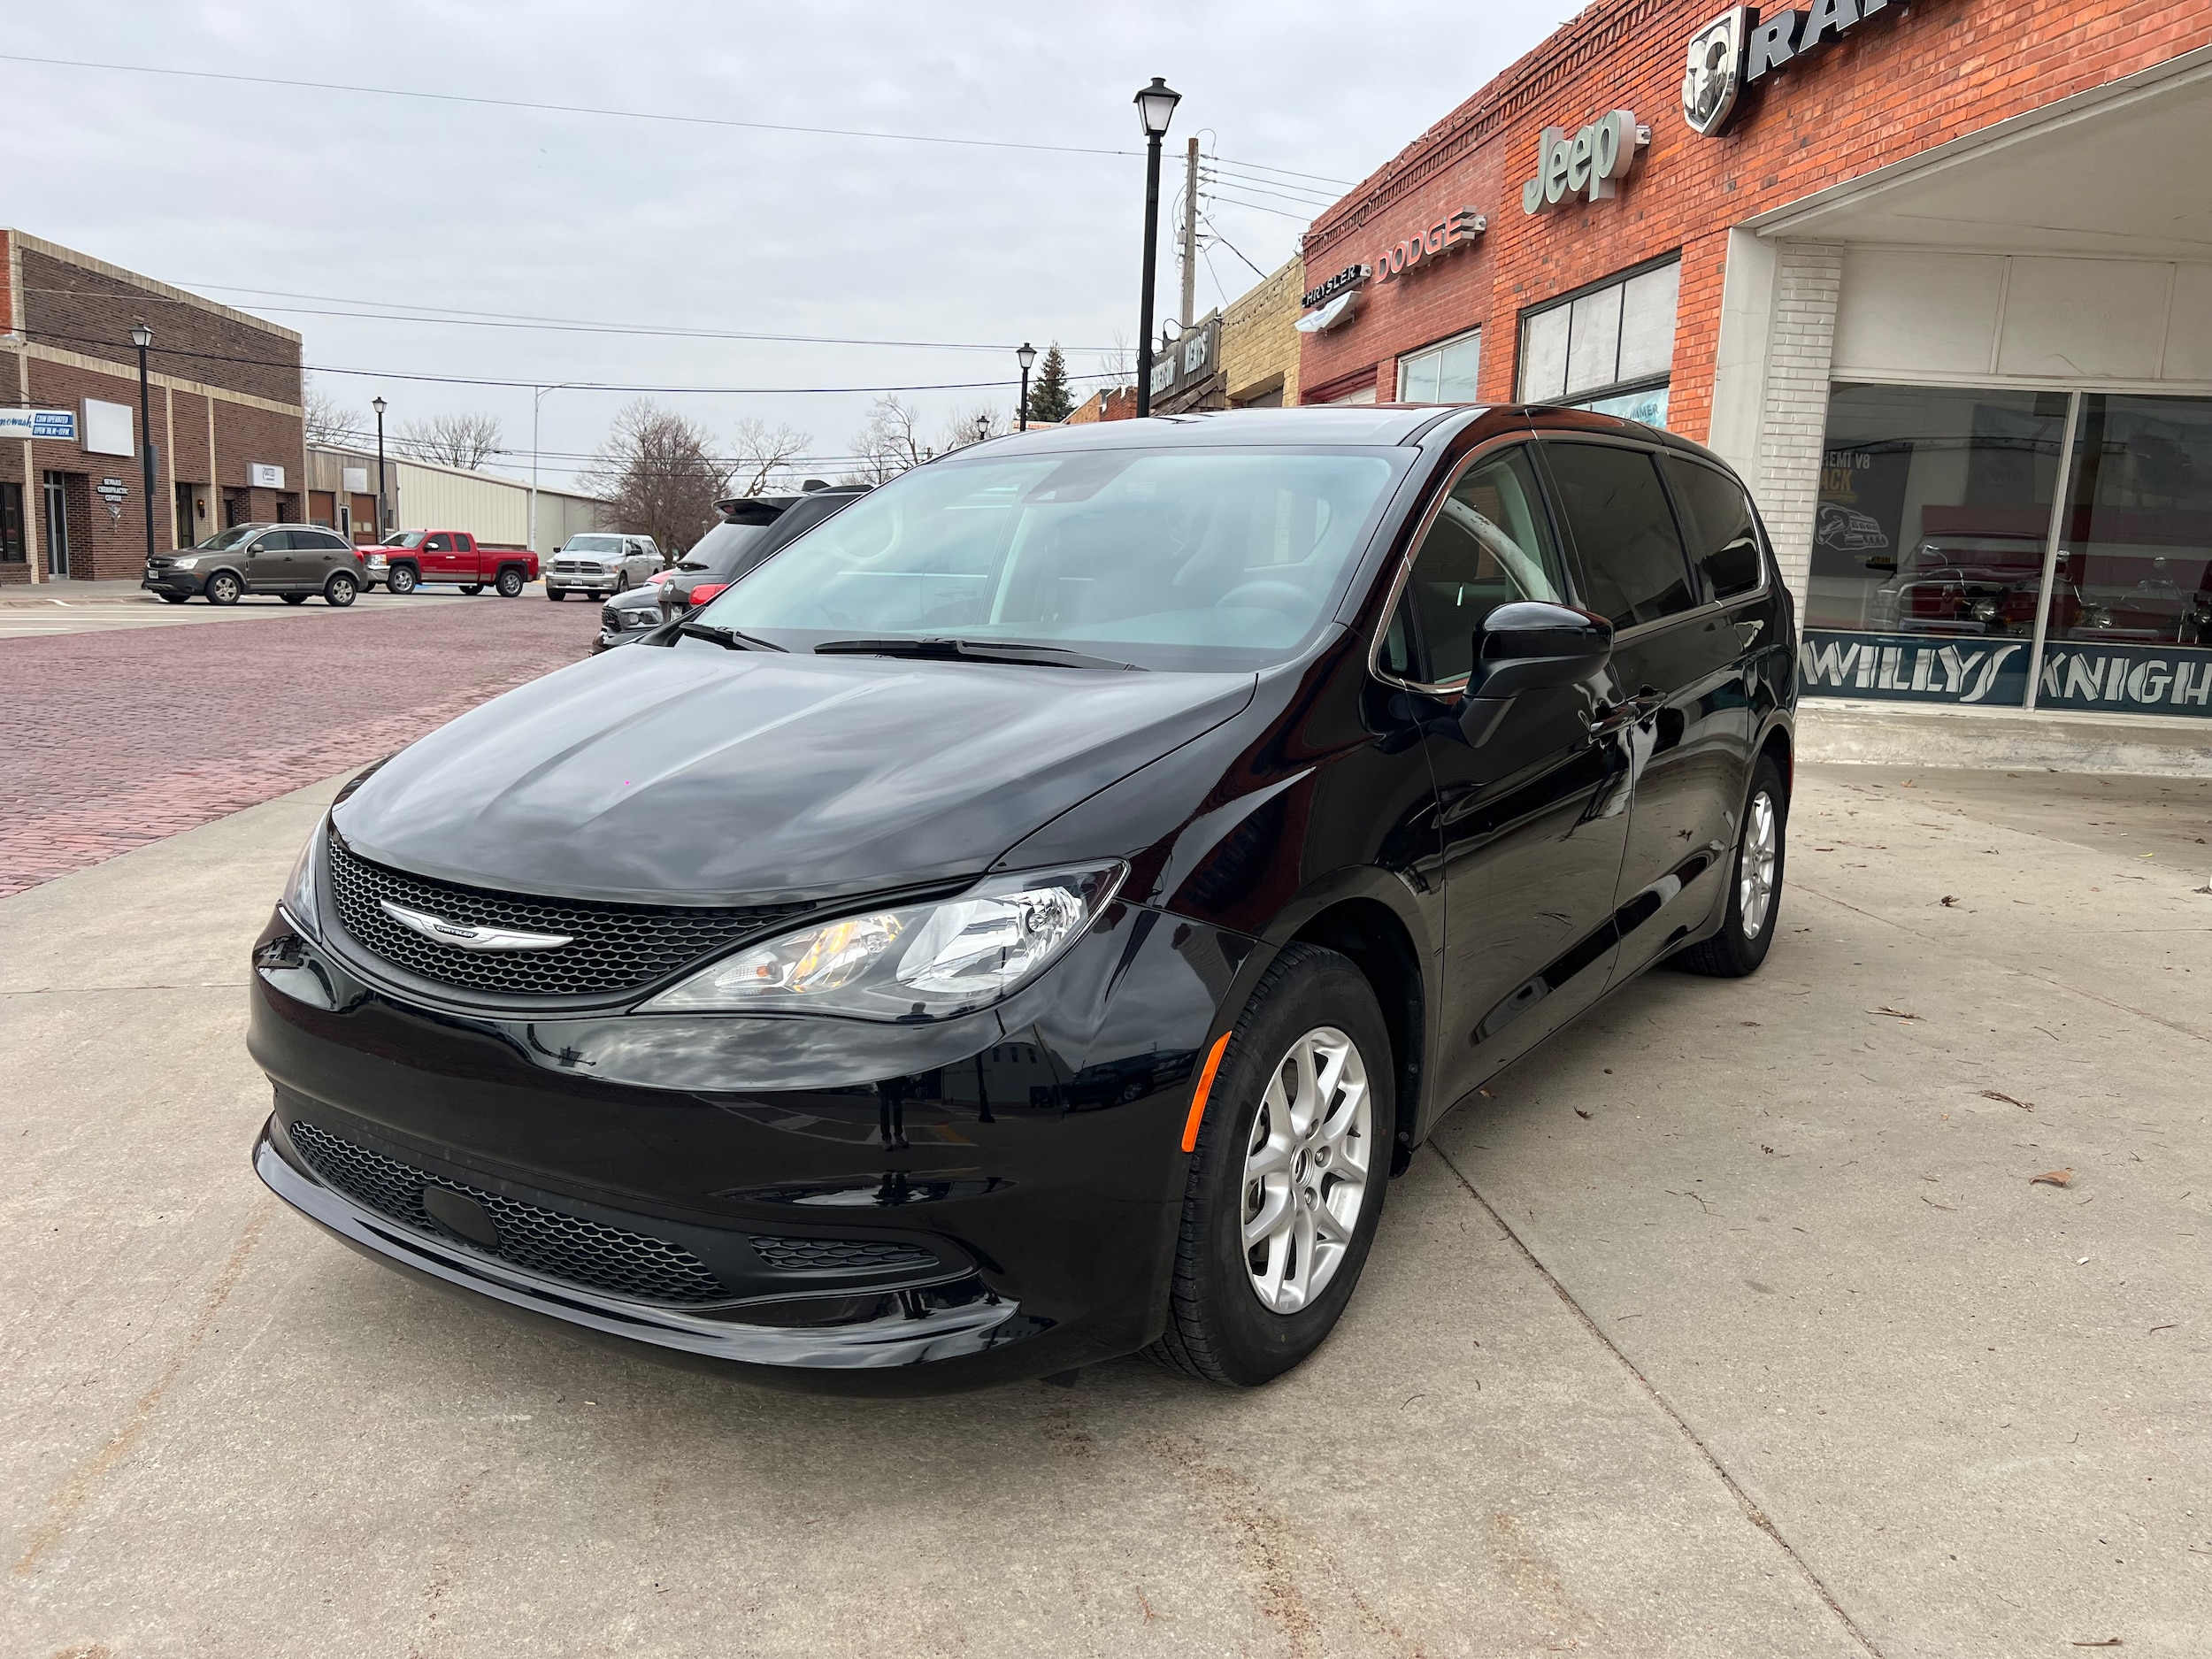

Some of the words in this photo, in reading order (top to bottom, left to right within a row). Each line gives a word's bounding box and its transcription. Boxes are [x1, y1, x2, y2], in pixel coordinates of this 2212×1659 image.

[1523, 111, 1628, 215] Jeep
[1375, 204, 1470, 284] DODGE
[1302, 264, 1356, 309] CHRYSLER
[1855, 452, 1870, 470] V8
[1801, 640, 2023, 703] WILLYS
[2038, 651, 2212, 706] KNIGH
[435, 926, 475, 938] CHRYSLER
